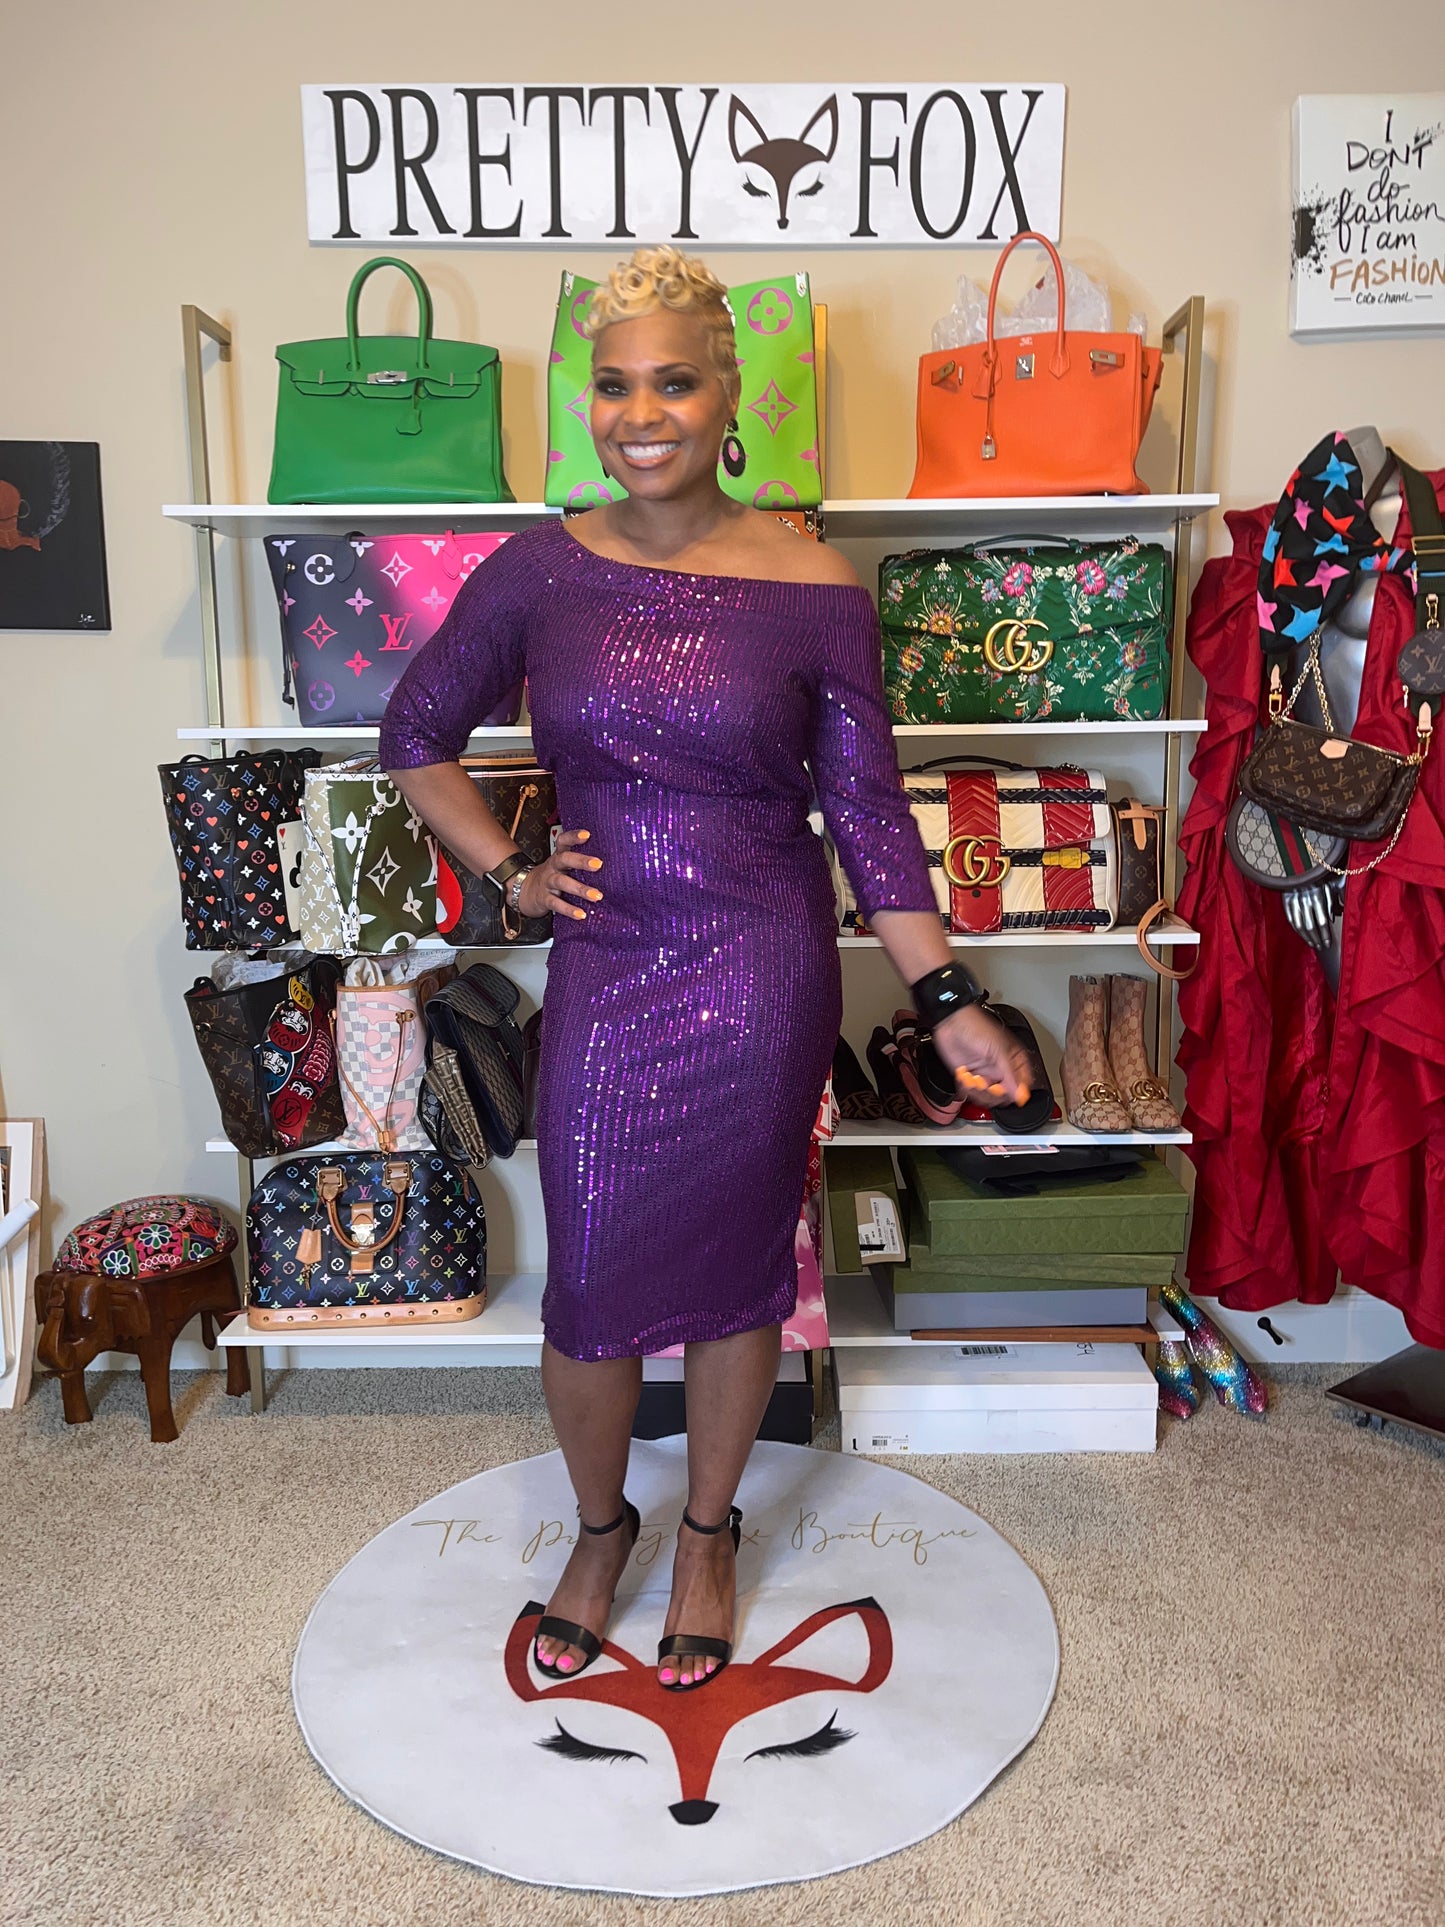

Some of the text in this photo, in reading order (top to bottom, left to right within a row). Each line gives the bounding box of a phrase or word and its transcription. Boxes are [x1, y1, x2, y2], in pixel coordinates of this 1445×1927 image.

[1386, 108, 1394, 144] I
[322, 87, 1045, 240] PRETTY FOX
[1367, 165, 1410, 203] do
[1332, 187, 1445, 254] fashion
[1361, 224, 1417, 254] I am
[790, 1507, 978, 1566] Boutique
